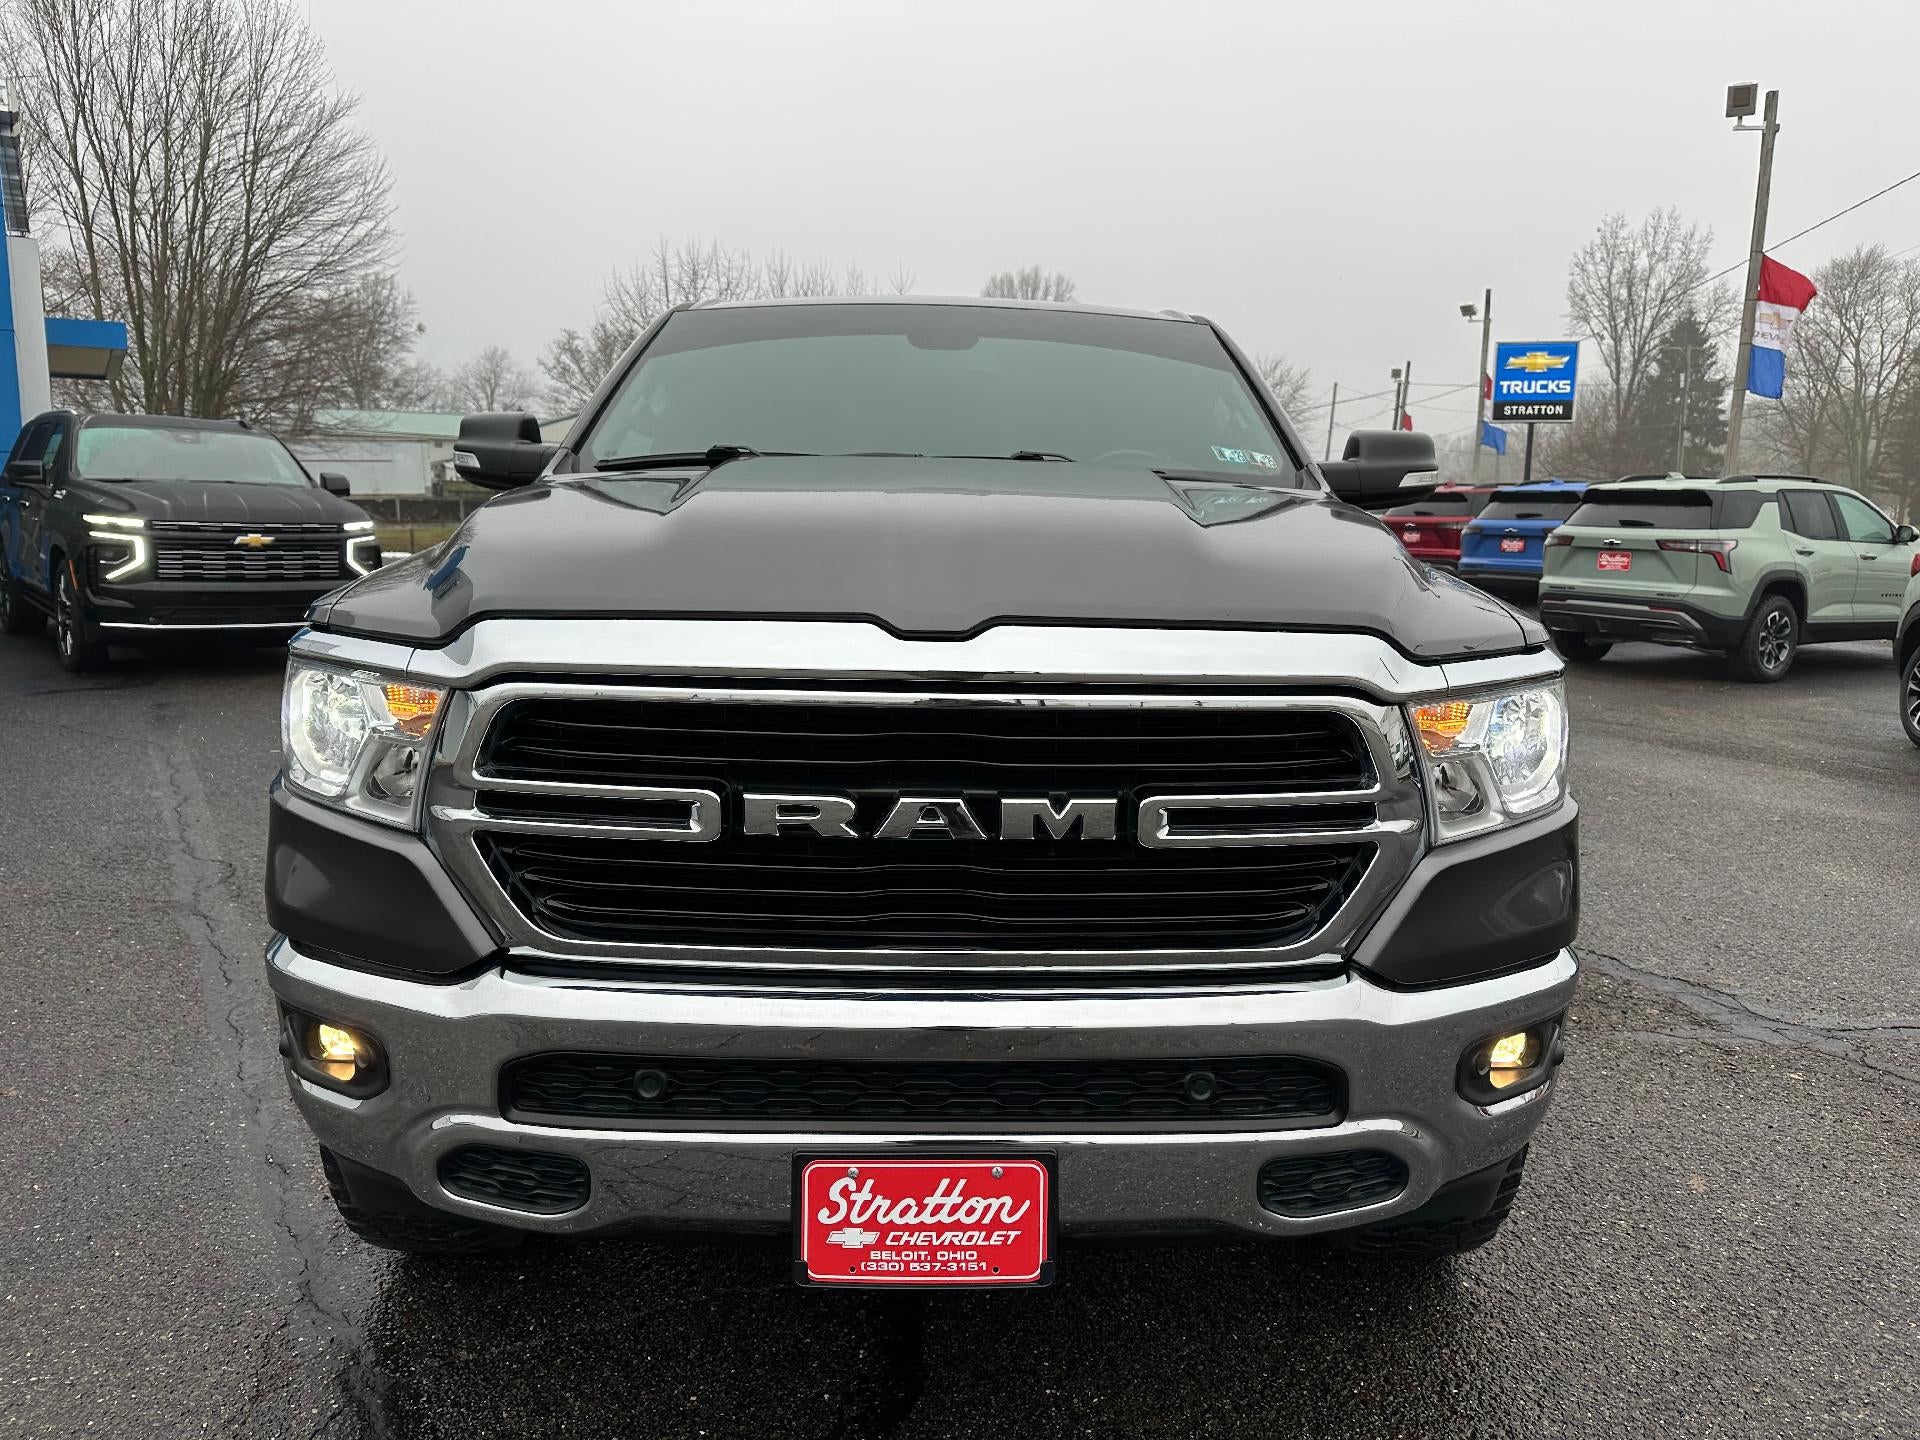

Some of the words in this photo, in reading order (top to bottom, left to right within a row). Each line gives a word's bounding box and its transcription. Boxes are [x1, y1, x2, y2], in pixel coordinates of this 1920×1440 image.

[1499, 379, 1571, 394] TRUCKS
[1503, 405, 1564, 416] STRATTON
[742, 793, 1119, 840] RAM
[817, 1176, 1031, 1225] Stratton
[885, 1230, 1021, 1246] CHEVROLET
[870, 1250, 931, 1261] BELOIT,
[936, 1250, 978, 1261] OHIO
[860, 1261, 905, 1272] (330)
